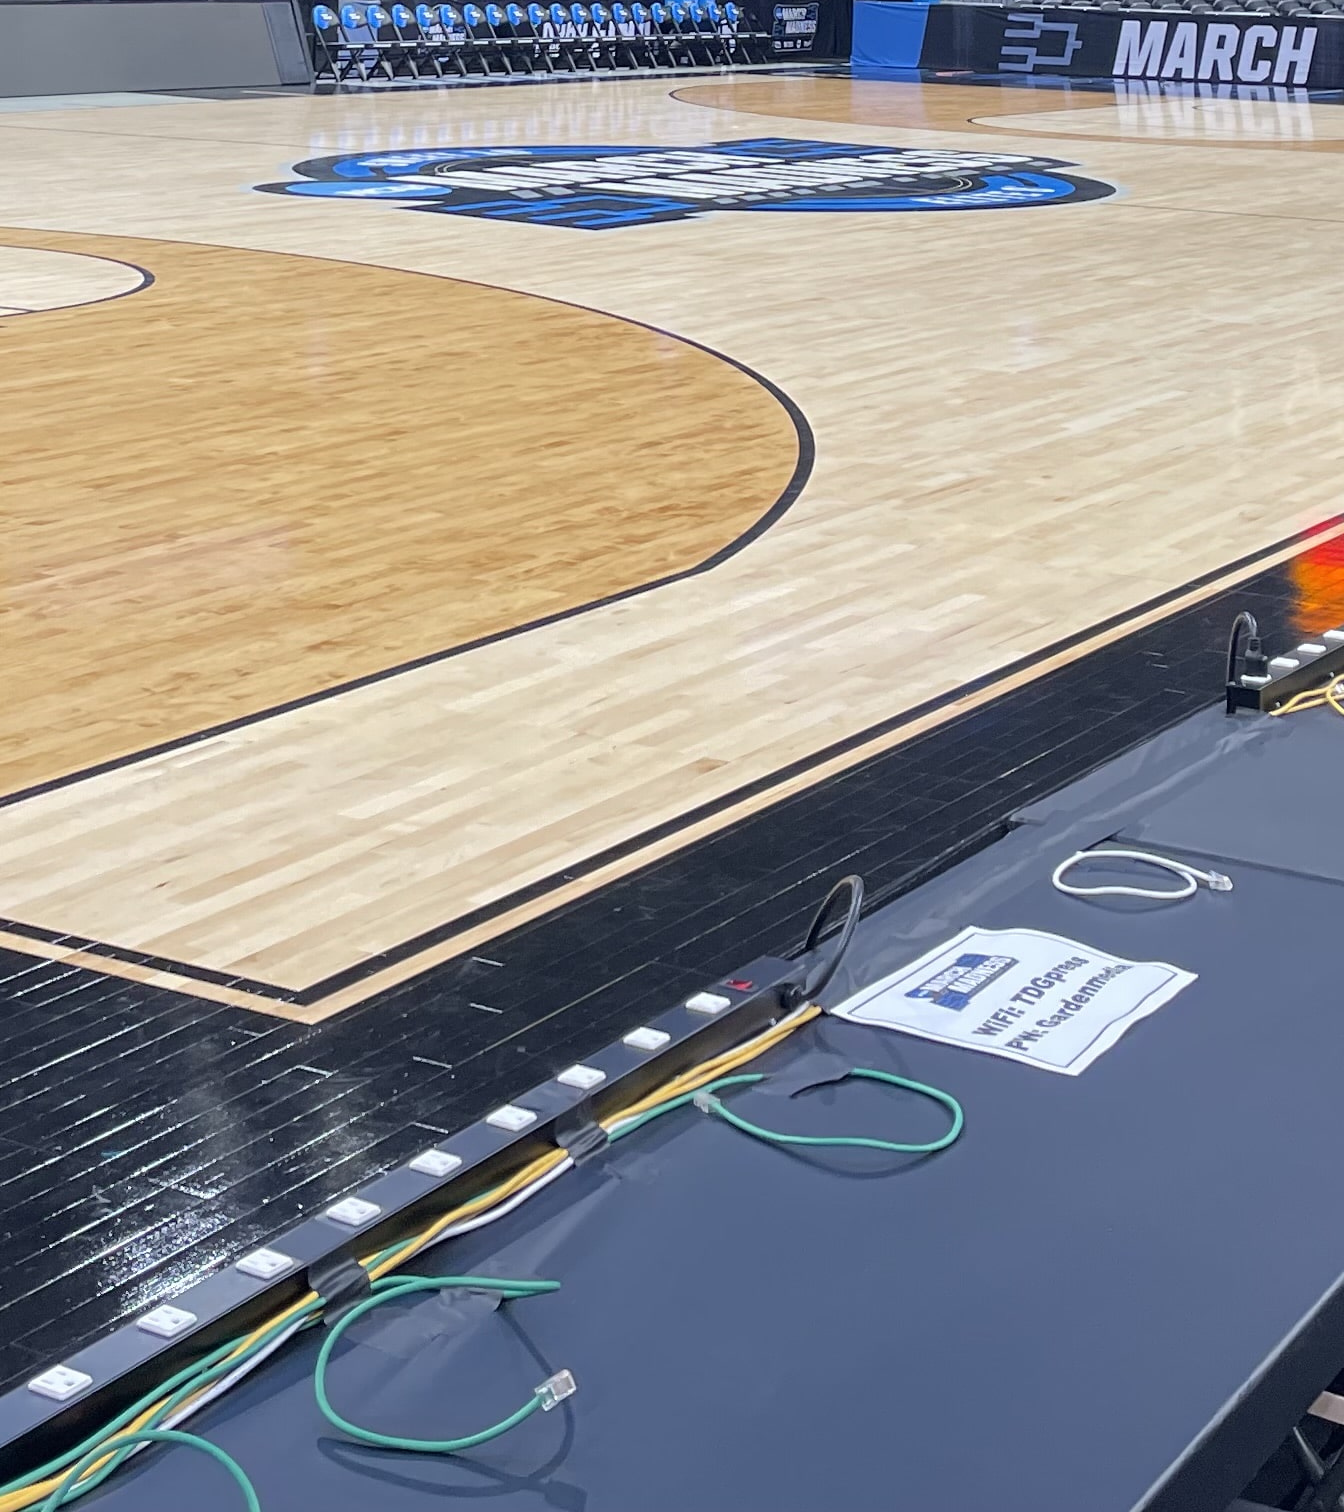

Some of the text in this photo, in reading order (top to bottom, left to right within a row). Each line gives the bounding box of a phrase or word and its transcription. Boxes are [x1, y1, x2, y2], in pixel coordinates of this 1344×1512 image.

[1112, 19, 1317, 85] MARCH
[386, 150, 785, 191] MARCH
[580, 150, 1033, 199] MADNESS
[971, 956, 1090, 1037] WiFi: TDGpress
[1004, 1029, 1048, 1052] PW:
